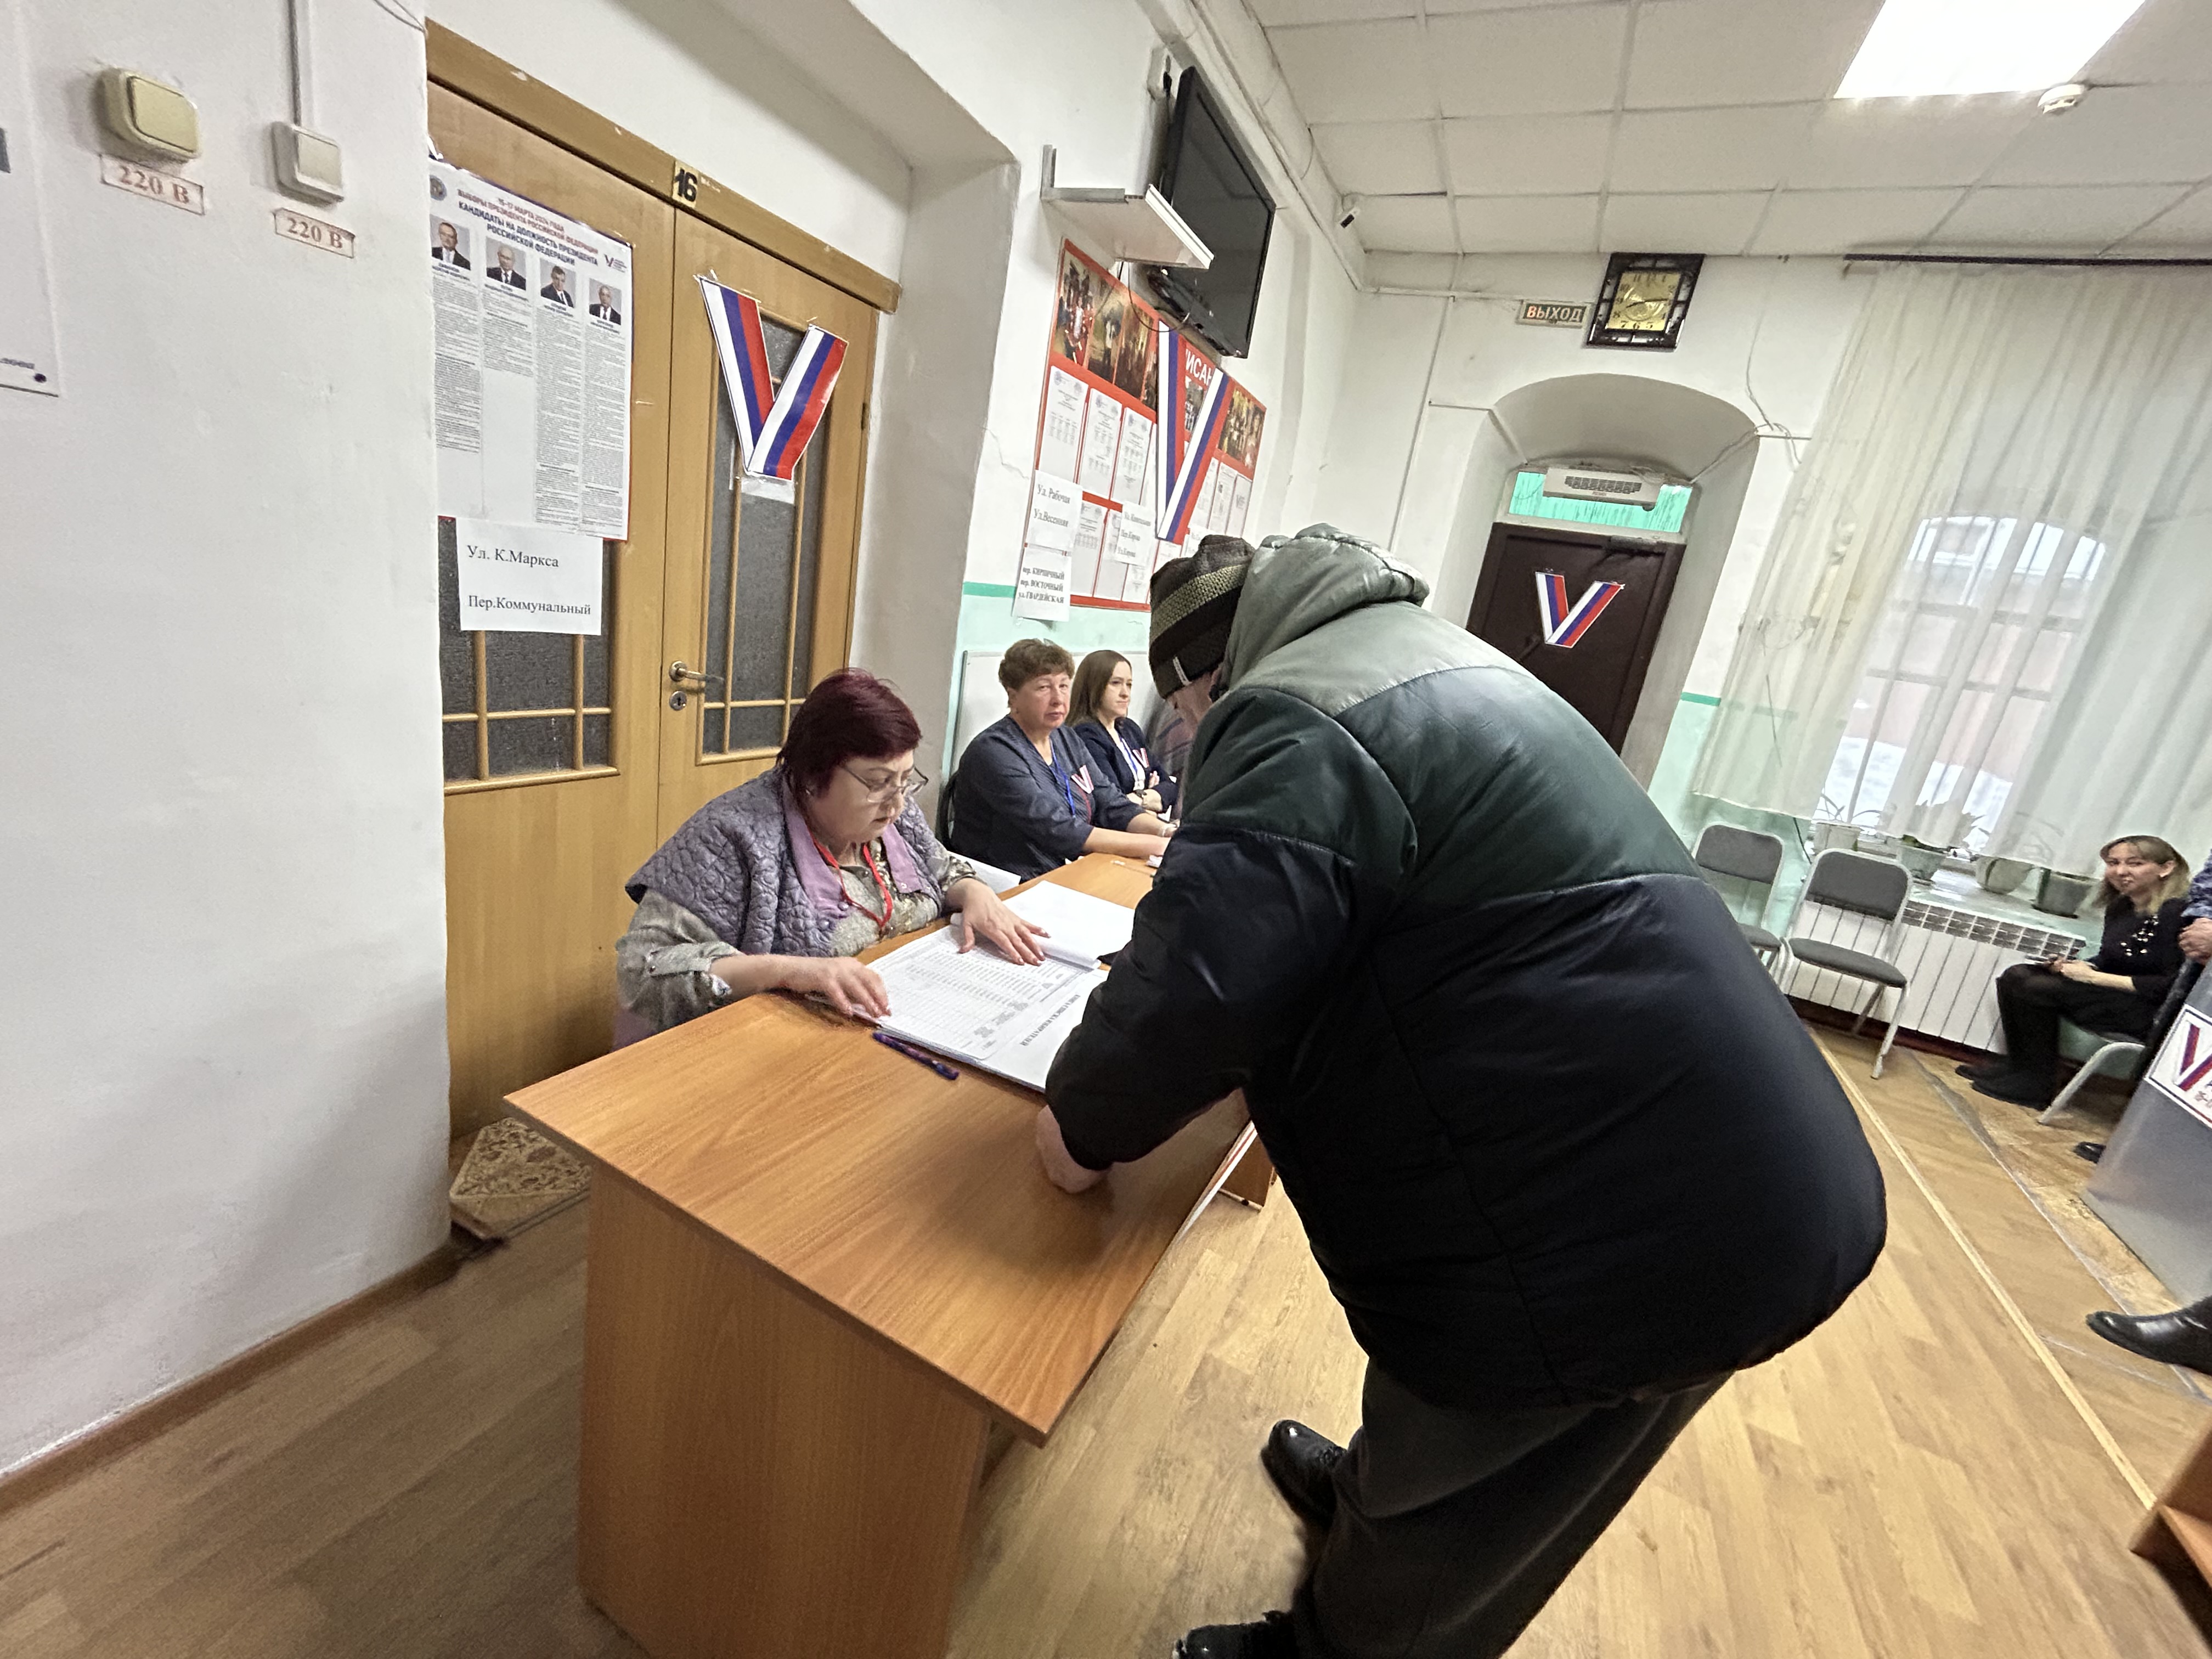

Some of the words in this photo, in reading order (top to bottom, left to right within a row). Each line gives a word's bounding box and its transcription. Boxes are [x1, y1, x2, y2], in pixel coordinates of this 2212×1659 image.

[119, 165, 163, 194] 220
[172, 182, 189, 204] В
[675, 167, 697, 202] 16
[287, 217, 321, 242] 220
[329, 230, 342, 248] В
[459, 201, 504, 226] КАНДИДАТЫ
[506, 221, 515, 230] НА
[516, 225, 557, 249] ДОЛЖНОСТЬ
[558, 243, 598, 266] ПРЕЗИДЕНТА
[487, 223, 534, 249] РОССИЙСКОЙ
[535, 244, 575, 266] ФЕДЕРАЦИИ
[1526, 305, 1583, 321] ВЫХОД
[467, 545, 490, 559] Ул.
[495, 548, 559, 568] К.Маркса
[1026, 591, 1064, 603] ГВАРДЕЙСКАЯ
[1030, 579, 1063, 592] ВОСТОЧНЫЙ
[469, 595, 591, 615] Пер.Коммунальный
